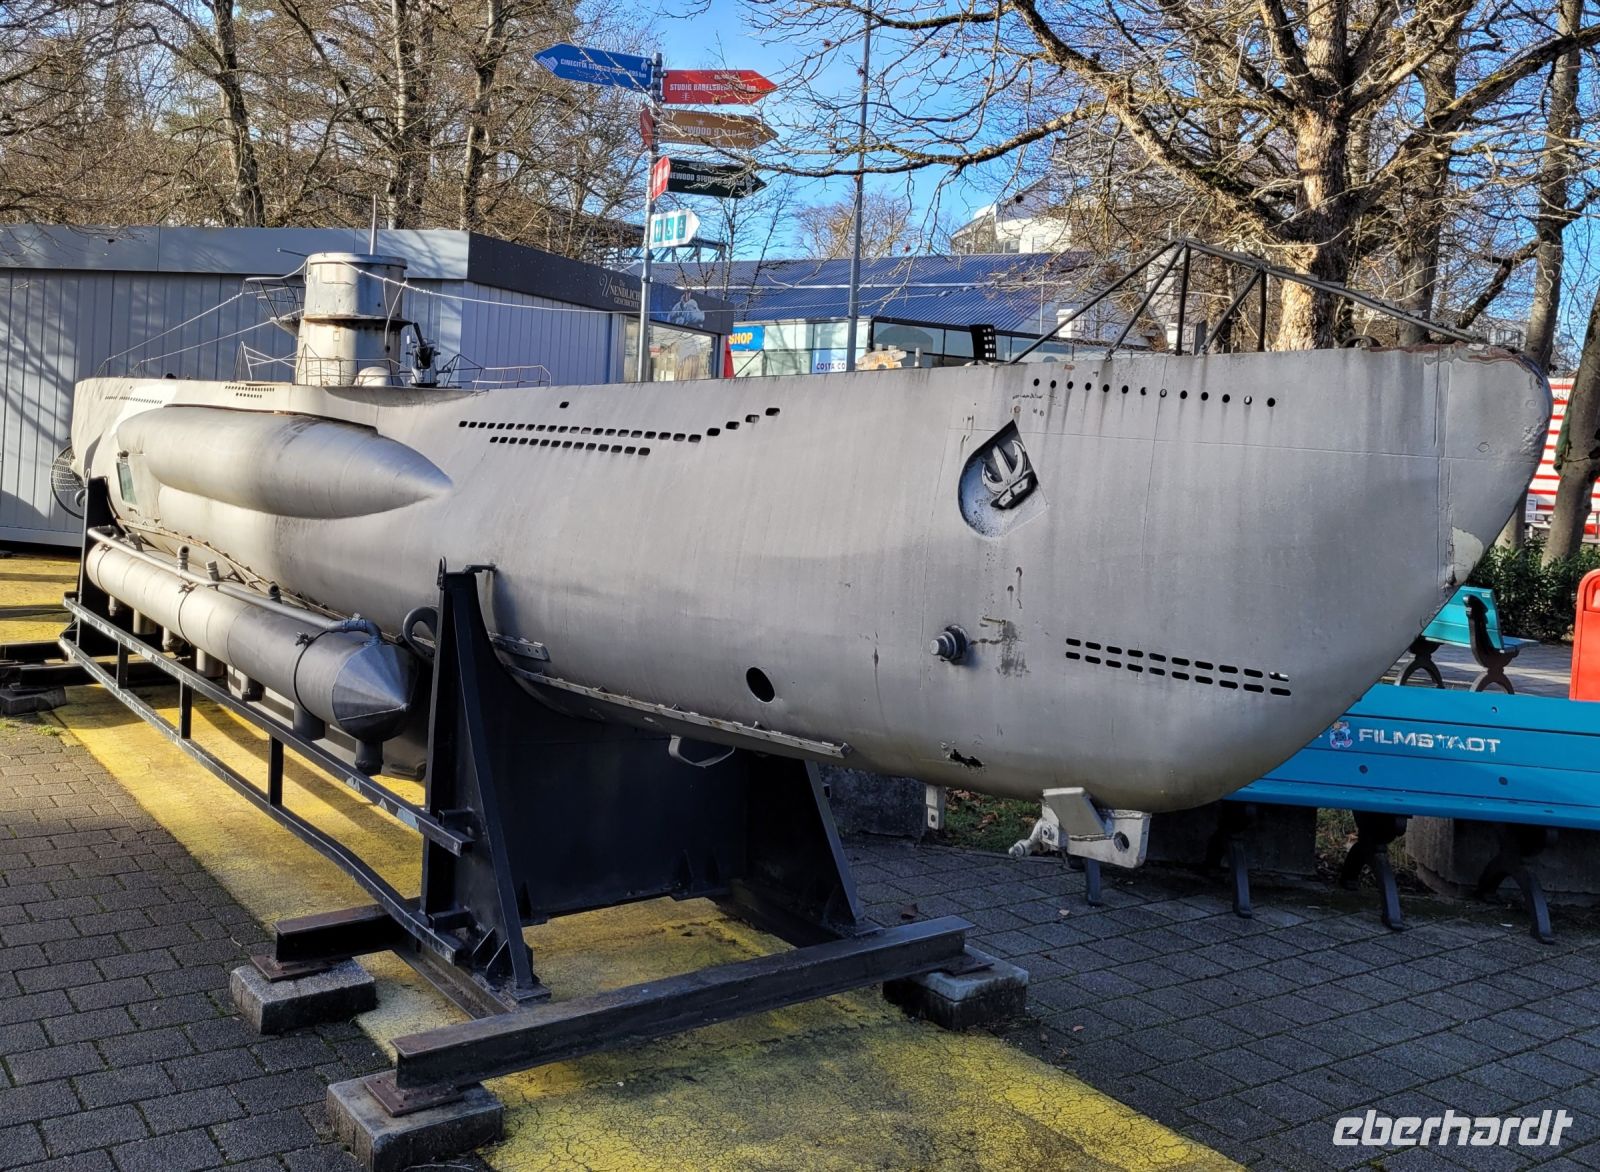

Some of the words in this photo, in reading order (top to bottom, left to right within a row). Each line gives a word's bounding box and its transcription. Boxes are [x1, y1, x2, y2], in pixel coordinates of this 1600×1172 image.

[669, 83, 692, 91] STUDIO
[728, 332, 753, 345] SHOP
[816, 361, 836, 371] COSTA
